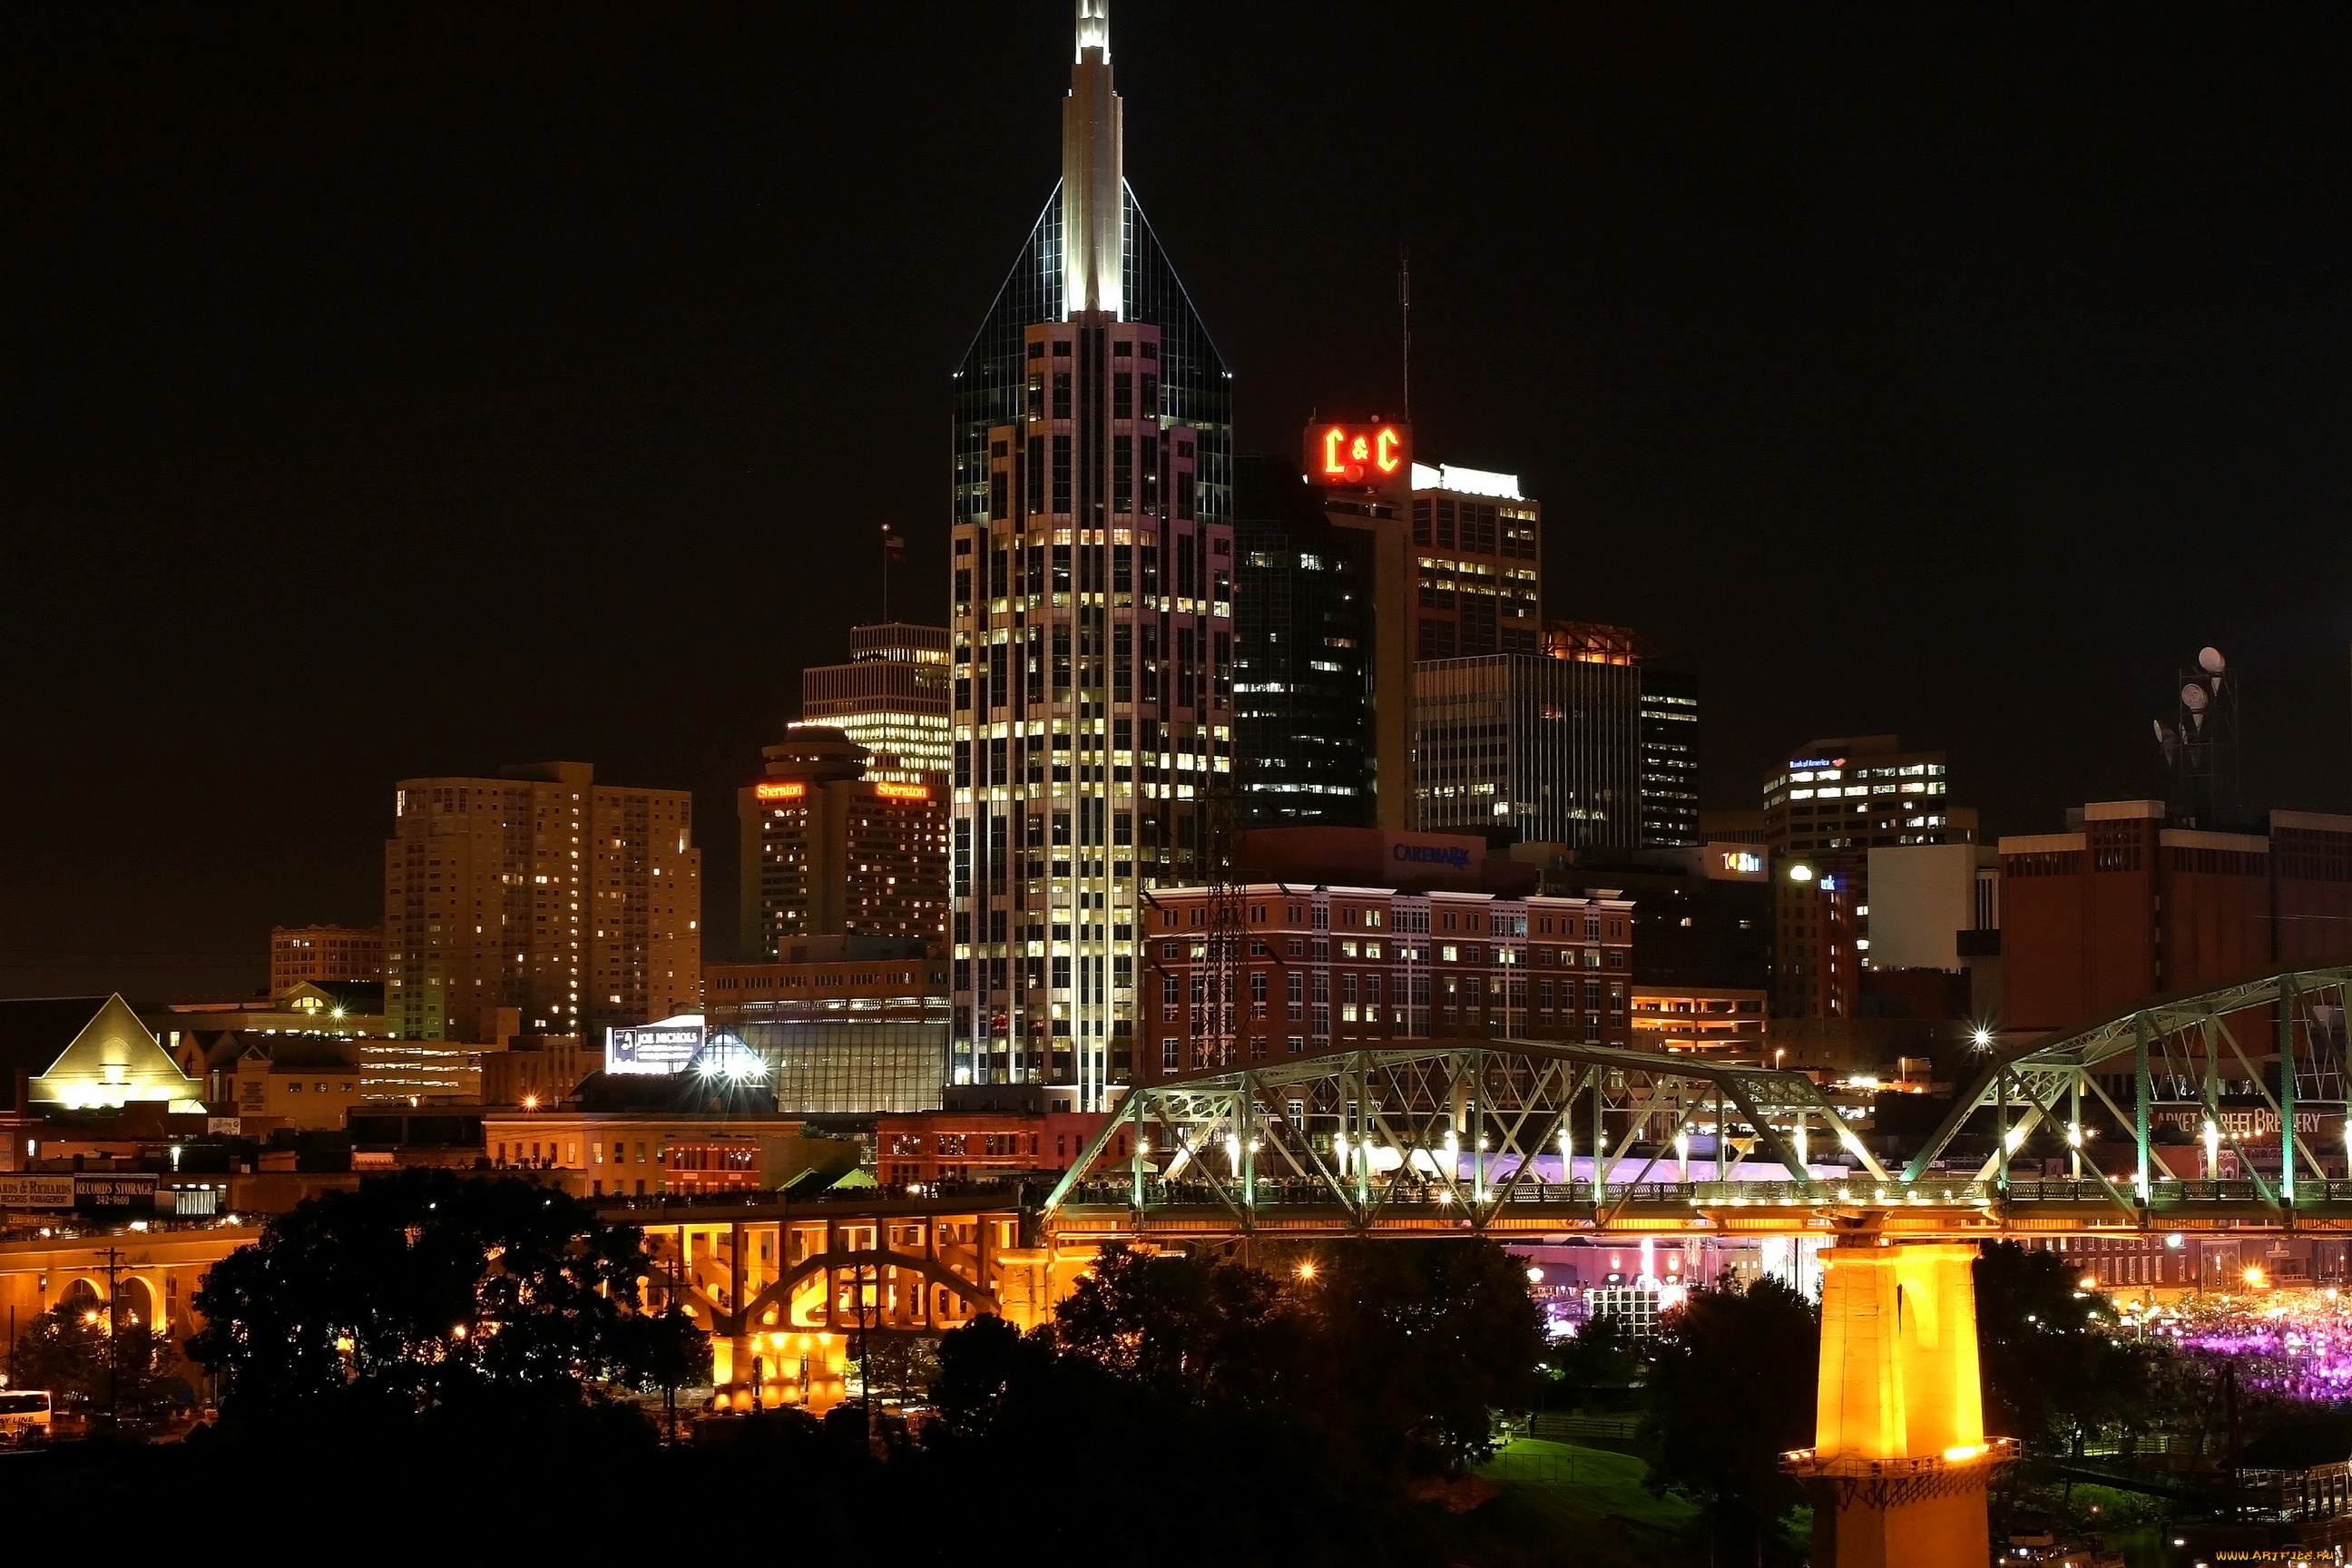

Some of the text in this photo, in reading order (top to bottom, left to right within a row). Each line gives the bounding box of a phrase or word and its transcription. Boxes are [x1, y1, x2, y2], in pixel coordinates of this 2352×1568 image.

[1326, 428, 1399, 473] L & C
[758, 784, 802, 798] Sheraton
[877, 782, 927, 798] Sheraton
[637, 1032, 698, 1047] JOE NICHOLS
[2254, 1107, 2320, 1133] BREERY
[29, 1180, 73, 1195] RICHARDS
[76, 1182, 154, 1195] RECORDS STORAGE
[13, 1416, 34, 1424] LINE
